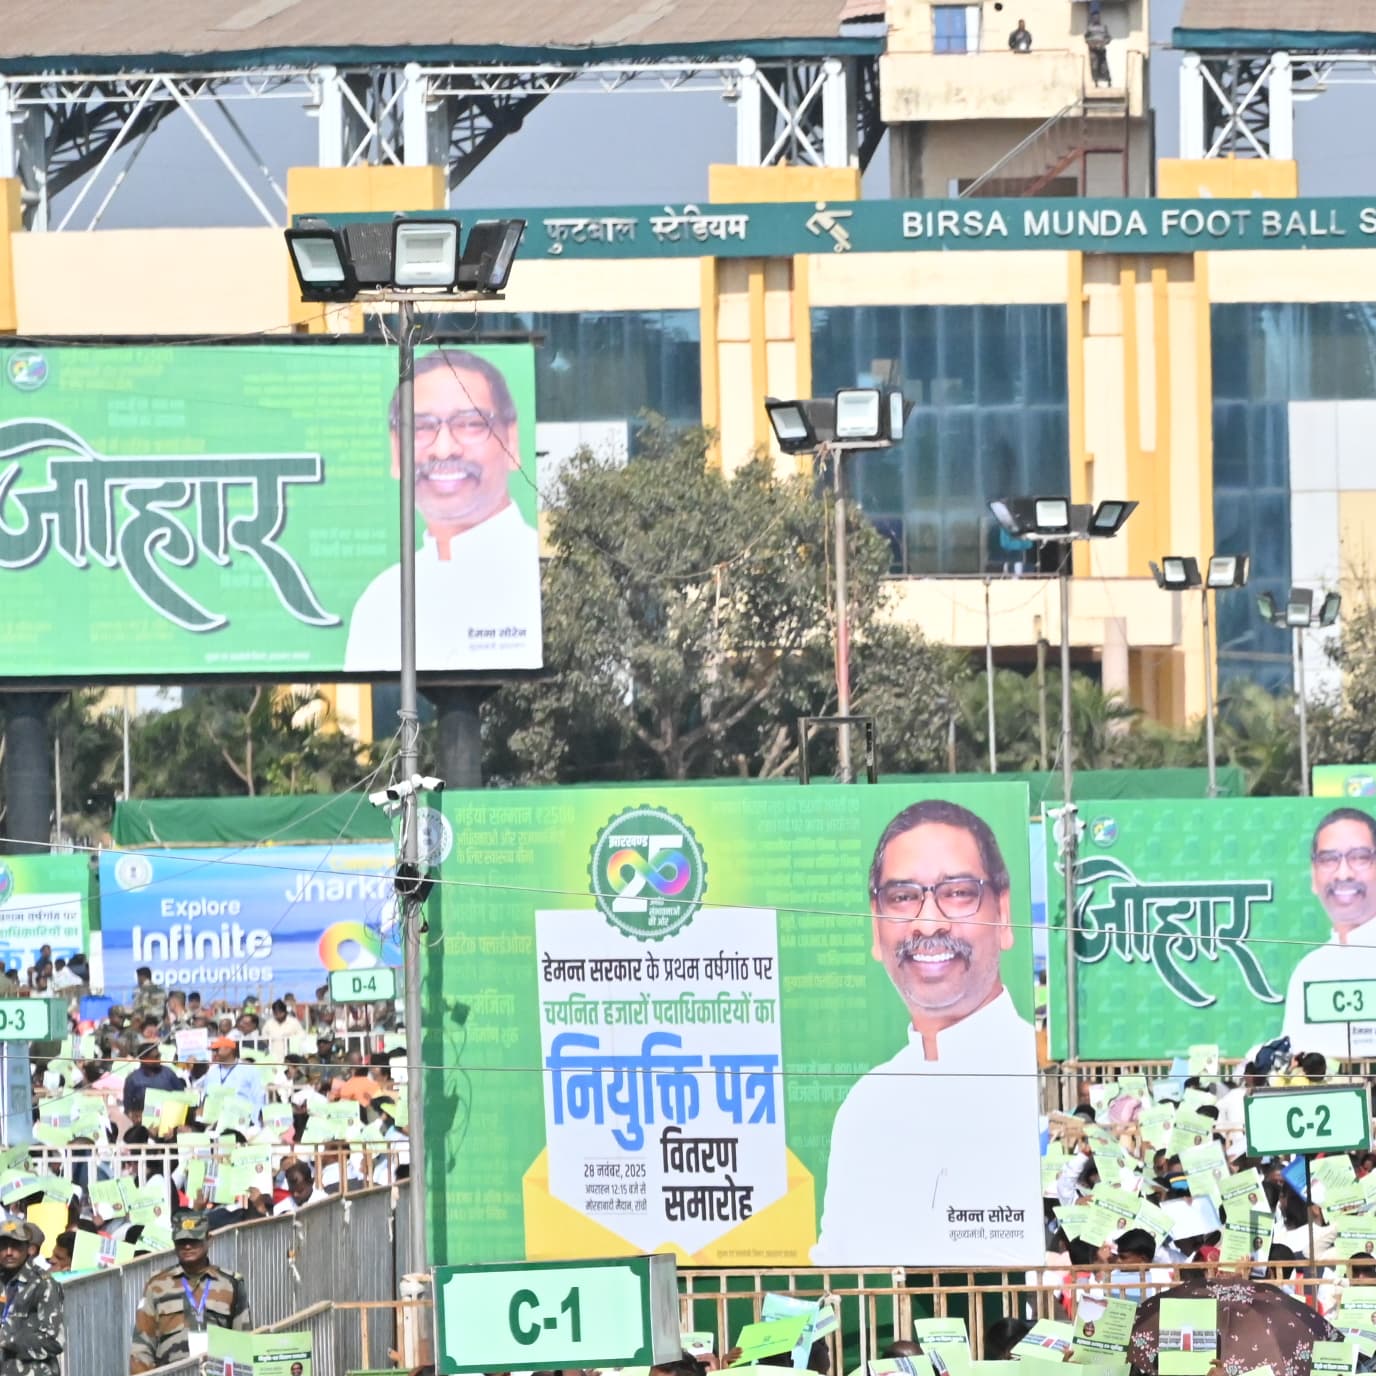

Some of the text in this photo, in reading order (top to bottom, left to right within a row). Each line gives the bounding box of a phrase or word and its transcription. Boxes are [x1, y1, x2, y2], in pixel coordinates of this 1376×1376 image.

[650, 204, 749, 243] स्टेडियम
[902, 210, 1007, 238] BIRSA
[1023, 210, 1147, 238] MUNDA
[1161, 209, 1250, 237] FOOT
[1261, 209, 1346, 237] BALL
[285, 874, 396, 903] Jhark
[161, 897, 241, 920] Explore
[132, 922, 273, 961] Infinite
[1054, 855, 1284, 1008] जोहार
[136, 965, 273, 987] pportunities
[542, 950, 773, 982] हेमन्त सरकार के प्रथम वर्षगांठ पर
[352, 976, 377, 993] D-4
[1332, 989, 1364, 1013] C-3
[544, 992, 599, 1025] चयनित
[602, 991, 650, 1025] हजारों
[652, 990, 752, 1025] पदाधिकारियों
[753, 998, 776, 1024] का
[546, 1032, 779, 1152] नियुक्ति पत्र
[1286, 1104, 1332, 1139] C-2
[660, 1125, 738, 1174] वितरण
[584, 1163, 595, 1178] 28
[625, 1163, 647, 1178] 2025
[662, 1174, 754, 1222] समारोह
[946, 1205, 1025, 1223] हेमन्त सोरेन
[508, 1286, 583, 1345] C-1
